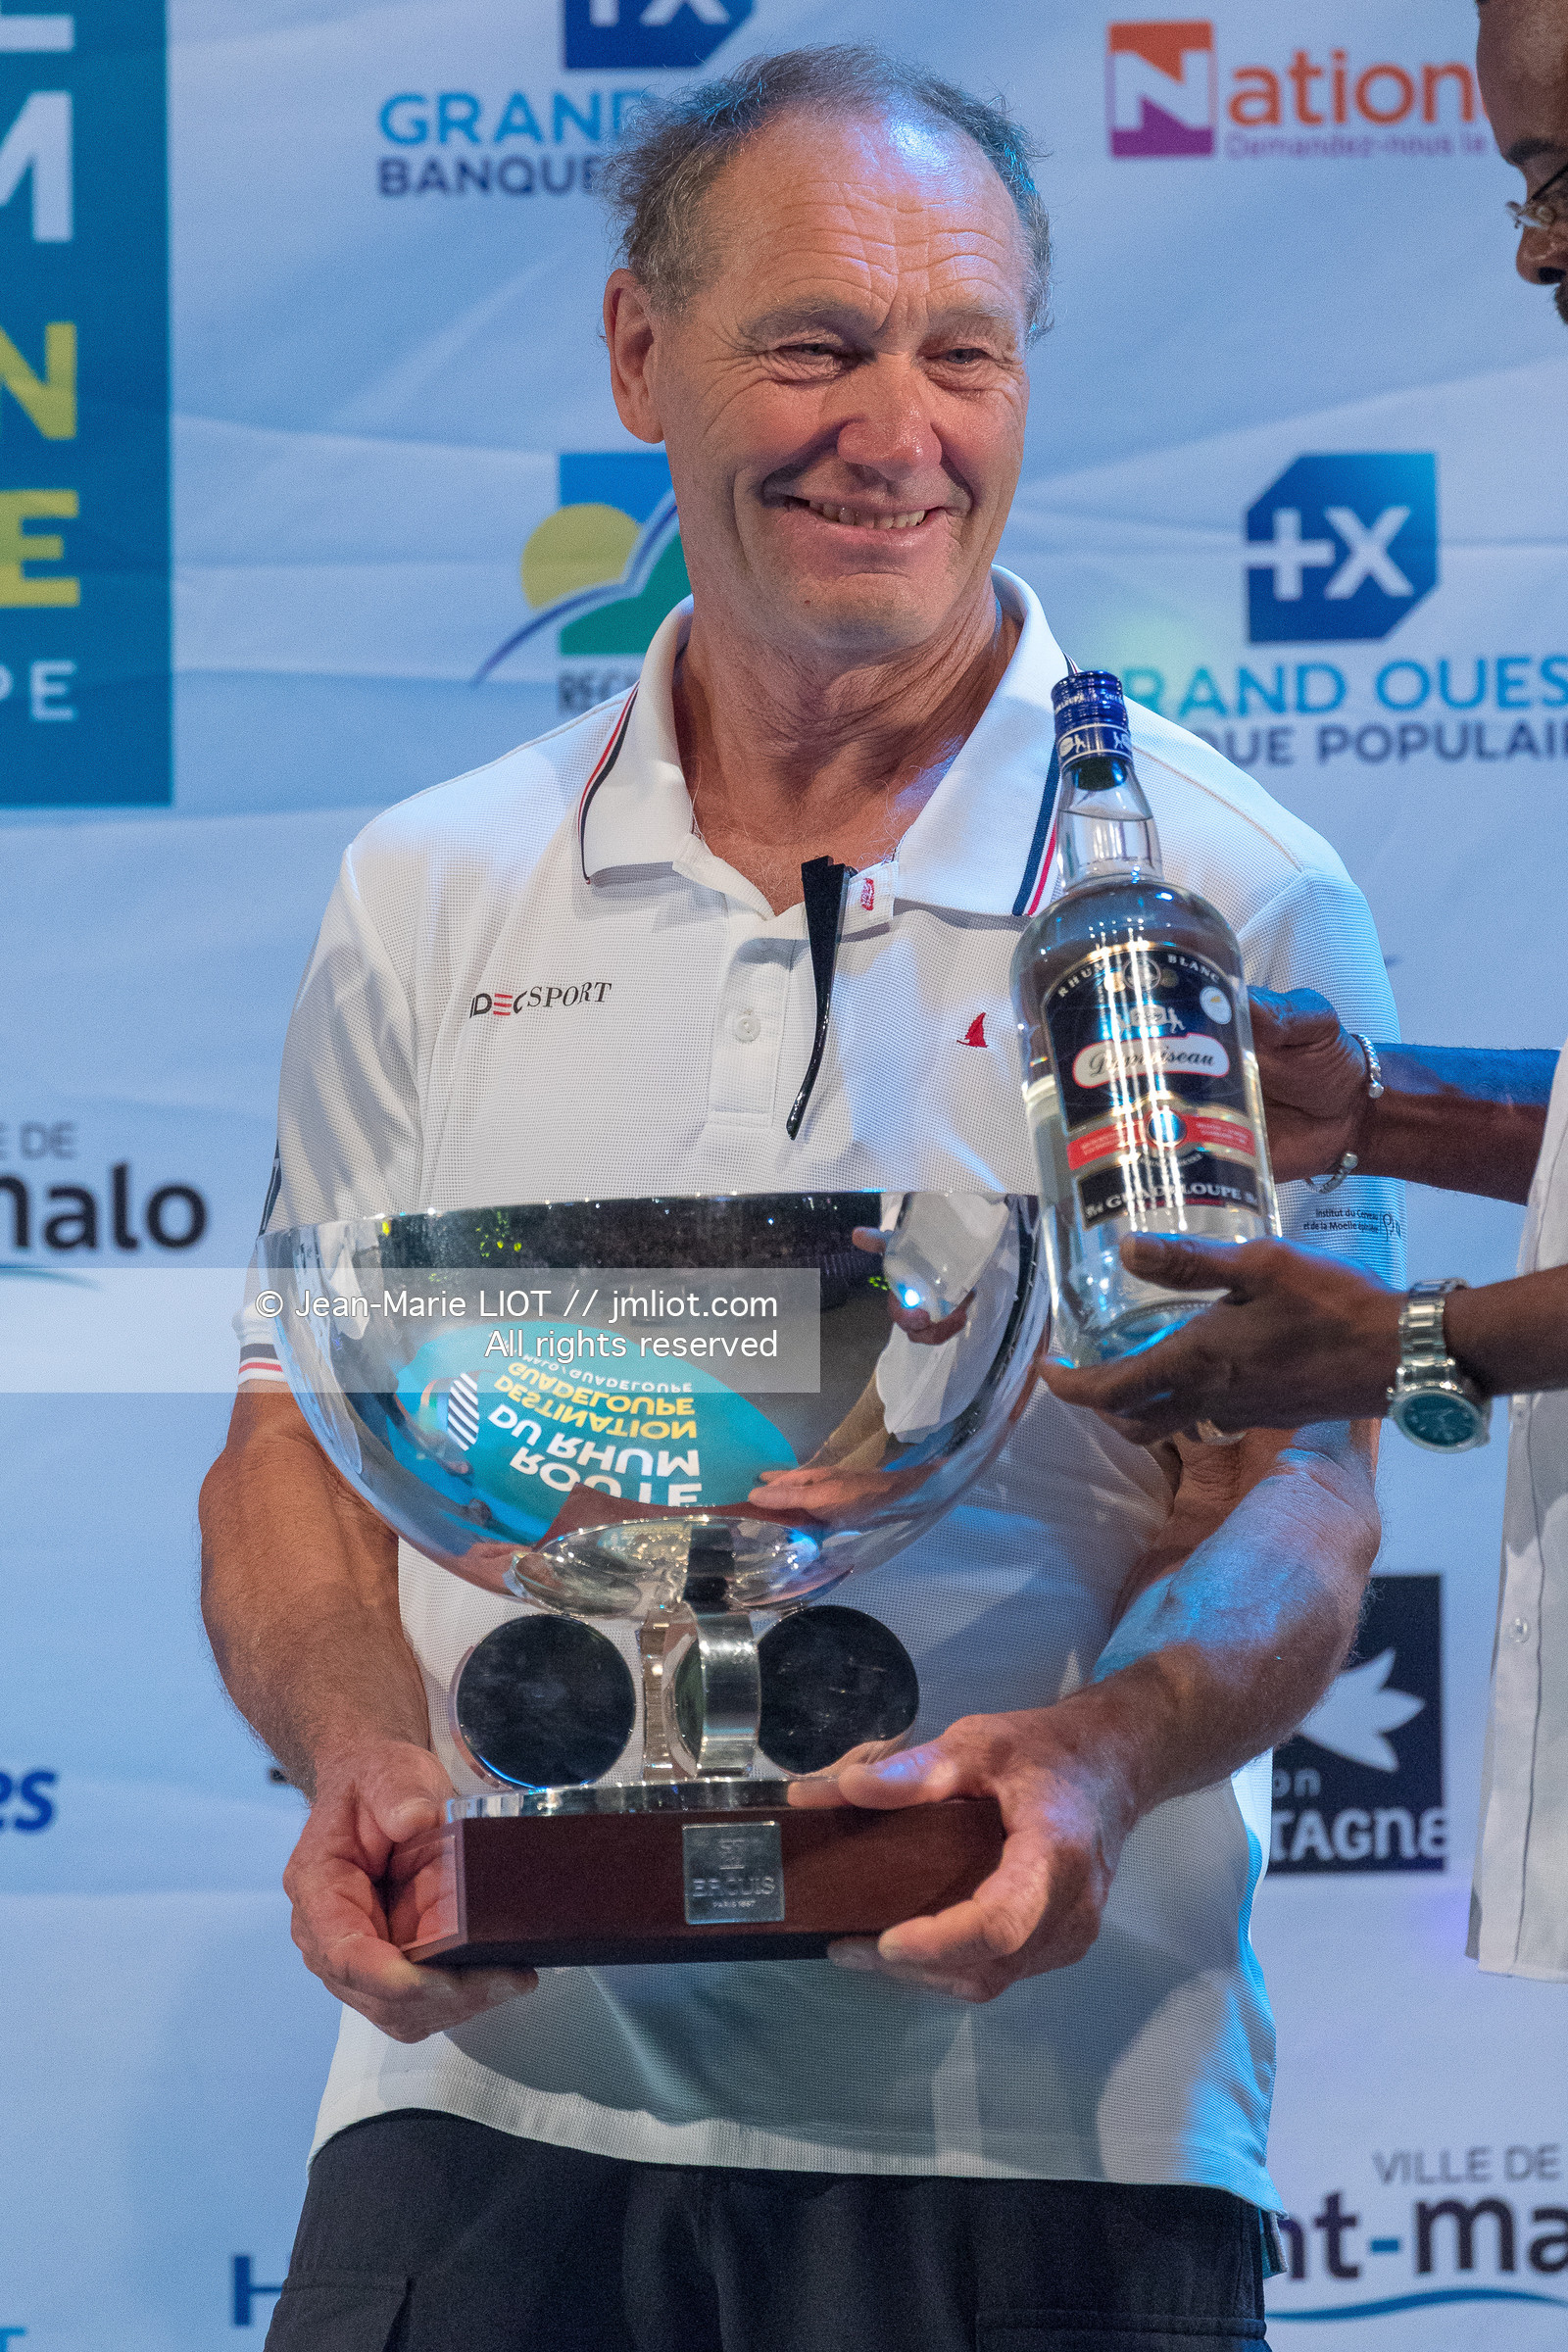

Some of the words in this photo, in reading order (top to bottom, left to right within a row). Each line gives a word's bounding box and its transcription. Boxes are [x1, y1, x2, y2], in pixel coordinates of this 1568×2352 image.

[0, 659, 77, 721] E
[1318, 717, 1568, 763] POPULAI
[526, 981, 612, 1008] SPORT
[1315, 1208, 1344, 1218] Institut
[1329, 1220, 1357, 1230] Moelle
[1373, 2146, 1493, 2185] VILLE
[1503, 2142, 1562, 2182] DE
